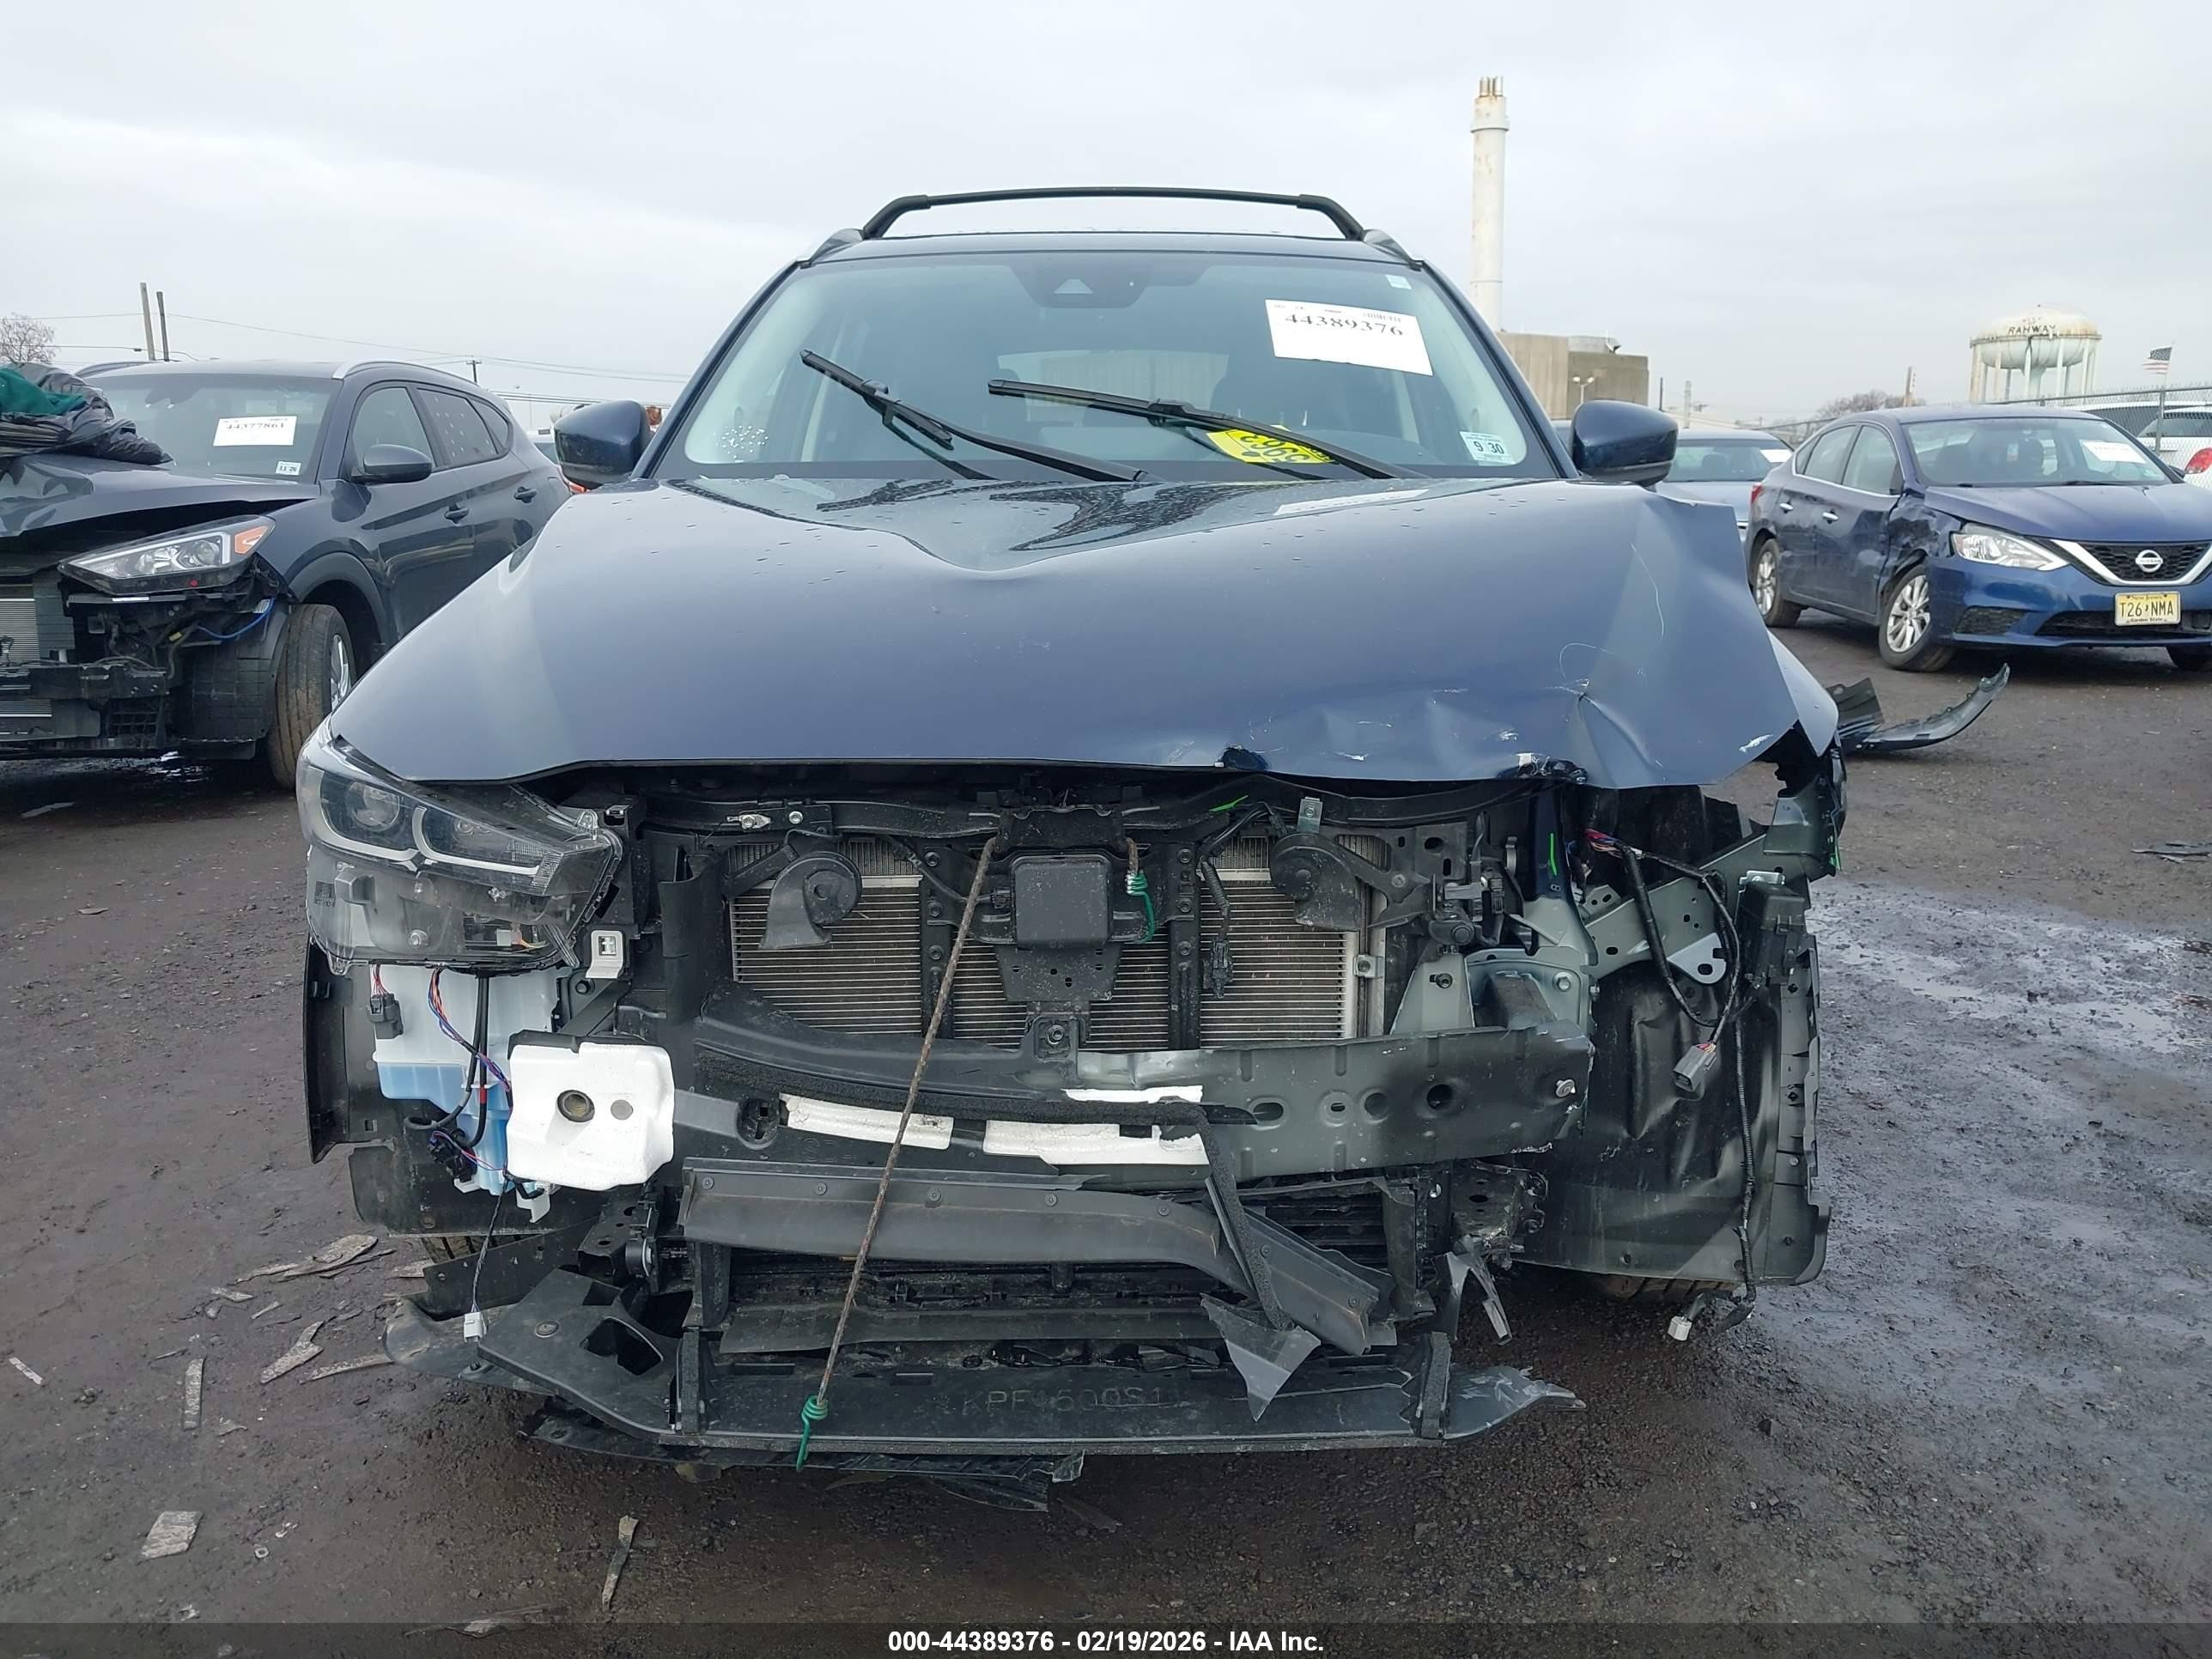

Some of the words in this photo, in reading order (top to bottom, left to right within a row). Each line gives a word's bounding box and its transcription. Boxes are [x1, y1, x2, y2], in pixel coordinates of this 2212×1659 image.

[1285, 314, 1403, 336] 44389376
[2008, 325, 2056, 335] RAHWAY
[1473, 441, 1485, 453] 9
[1487, 441, 1505, 454] 30
